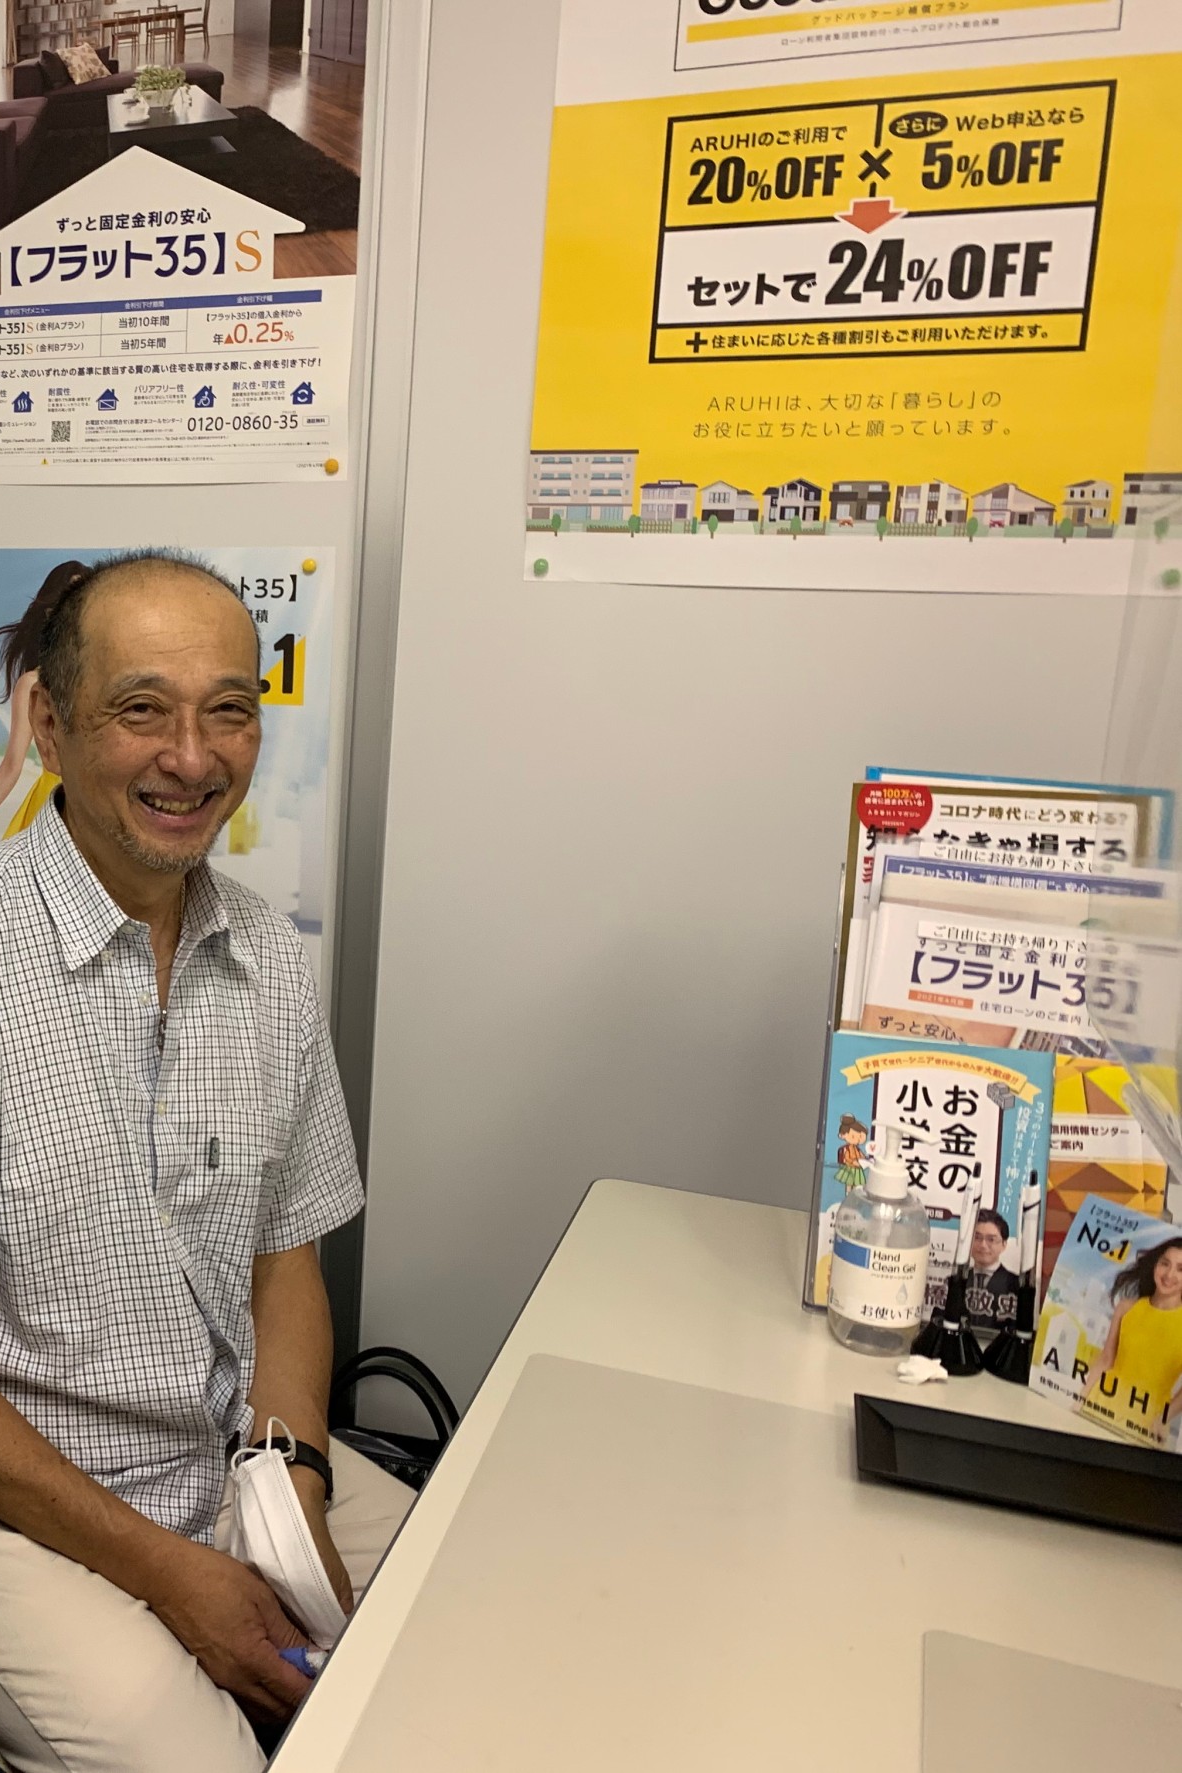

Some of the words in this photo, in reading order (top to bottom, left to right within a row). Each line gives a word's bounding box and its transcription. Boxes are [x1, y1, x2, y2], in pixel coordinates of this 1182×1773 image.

[893, 115, 944, 134] さらに
[956, 106, 1086, 131] Web申込なら
[689, 124, 848, 153] ARUHIのご利用で
[687, 153, 845, 206] 20%OFF
[921, 138, 1065, 190] 5%OFF
[56, 207, 212, 233] ずっと固定金利の安心
[118, 315, 170, 329] 当初10年間
[120, 337, 167, 350] 当初5年間
[48, 387, 71, 396] 耐震性
[134, 384, 185, 394] バリアフリー性
[707, 390, 1002, 412] ARUHIは、大切な「暮らし」の
[187, 414, 299, 432] 0120-0860-35
[692, 418, 1011, 439] お役に立ちたいと願っています。
[933, 924, 1118, 954] ご自由にお持ち帰り下さ
[910, 951, 1140, 1015] 【フラット35】
[980, 1001, 1082, 1026] 住宅ローンのご案内
[937, 1085, 980, 1193] お金の
[1077, 1220, 1131, 1261] No.1
[872, 1262, 900, 1273] Clean
[902, 1263, 917, 1274] Gel
[873, 1250, 901, 1262] Hand
[1043, 1347, 1170, 1424] ARUHI
